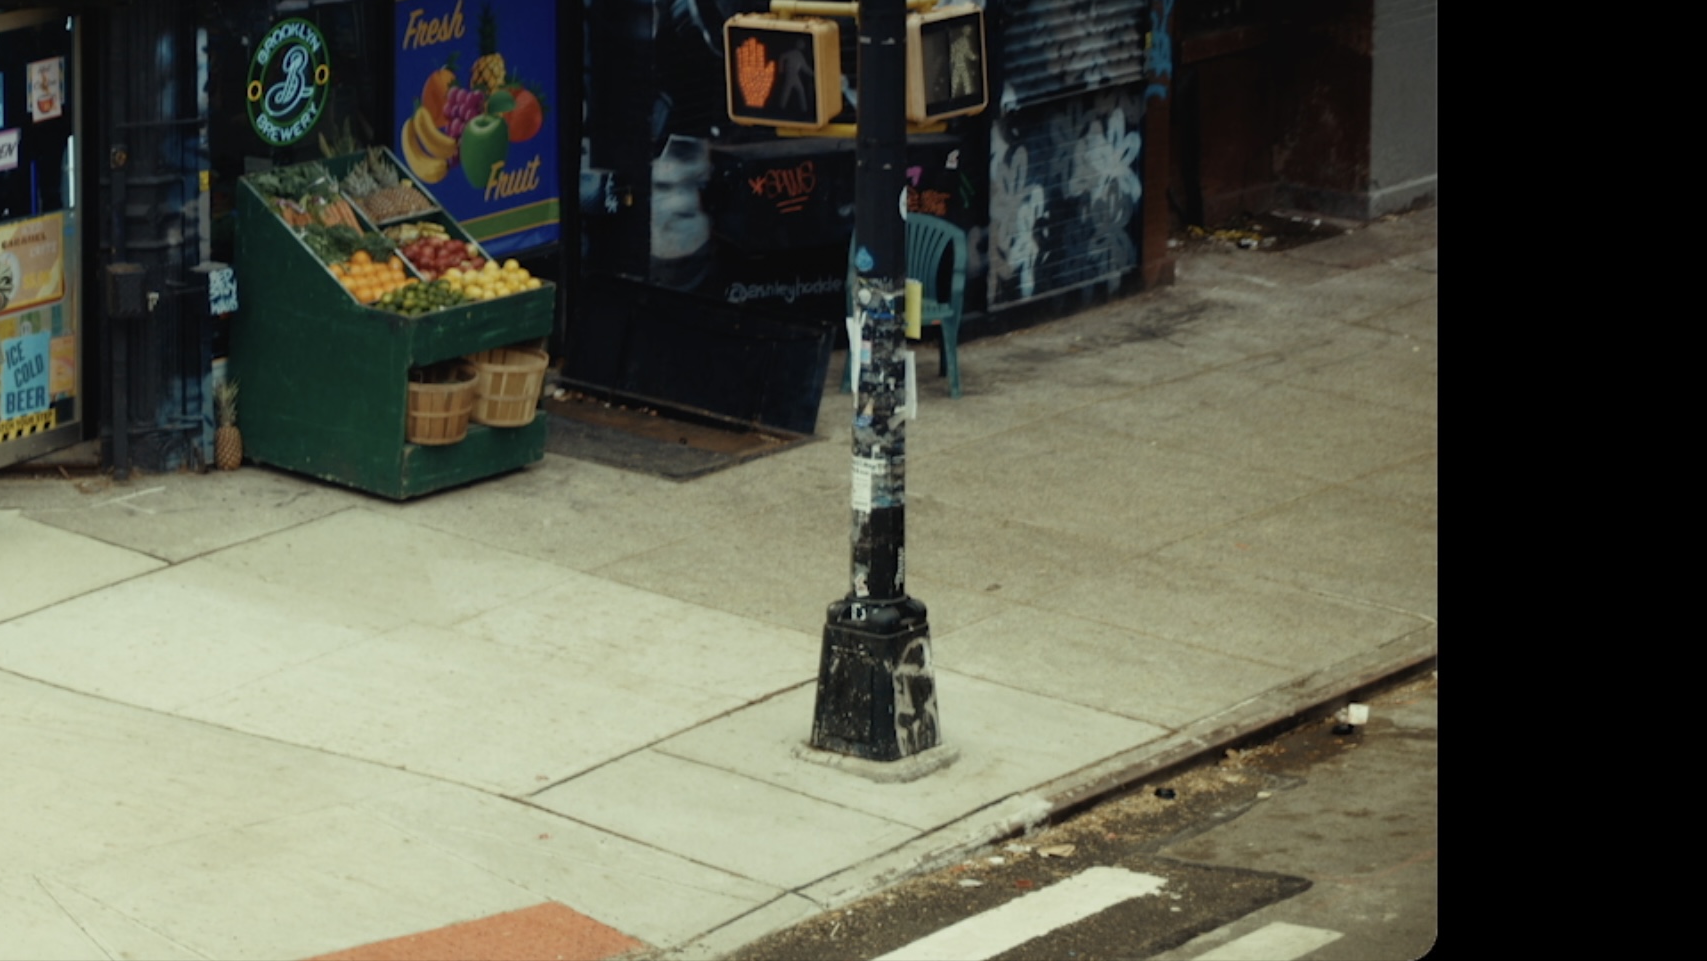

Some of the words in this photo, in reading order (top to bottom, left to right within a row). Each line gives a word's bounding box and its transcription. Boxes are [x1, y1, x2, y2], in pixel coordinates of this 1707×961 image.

[257, 22, 322, 65] BROOKLYN
[255, 101, 318, 142] BREWERY
[484, 154, 540, 202] Fruit
[5, 340, 26, 369] ICE
[14, 353, 45, 388] COLD
[5, 385, 46, 415] BEER
